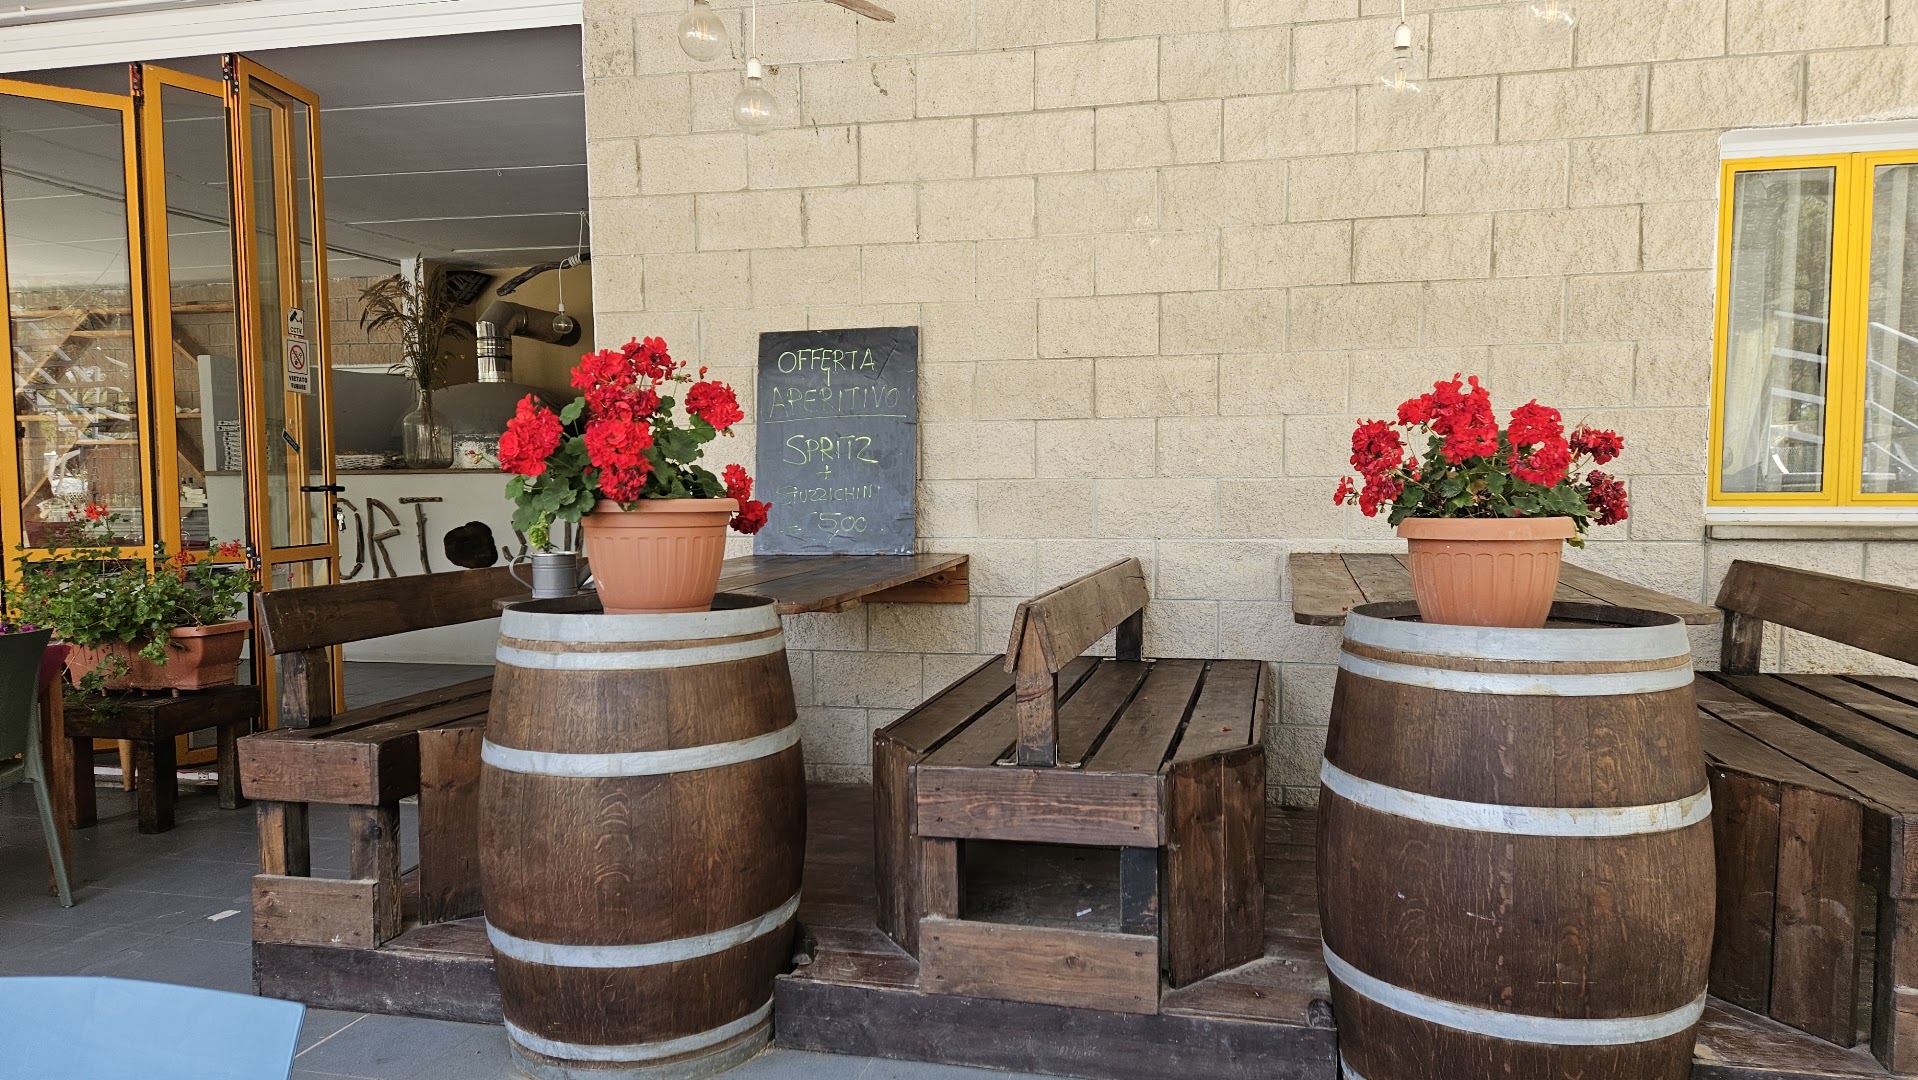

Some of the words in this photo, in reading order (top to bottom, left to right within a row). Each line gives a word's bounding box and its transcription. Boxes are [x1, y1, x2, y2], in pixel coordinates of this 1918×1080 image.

[290, 326, 303, 335] CCTV
[777, 348, 876, 374] OFFERTA
[288, 375, 308, 383] VIETATO
[769, 385, 901, 418] APERITIVO
[782, 434, 879, 466] SPRITZ
[775, 484, 881, 506] STUZZICHINI
